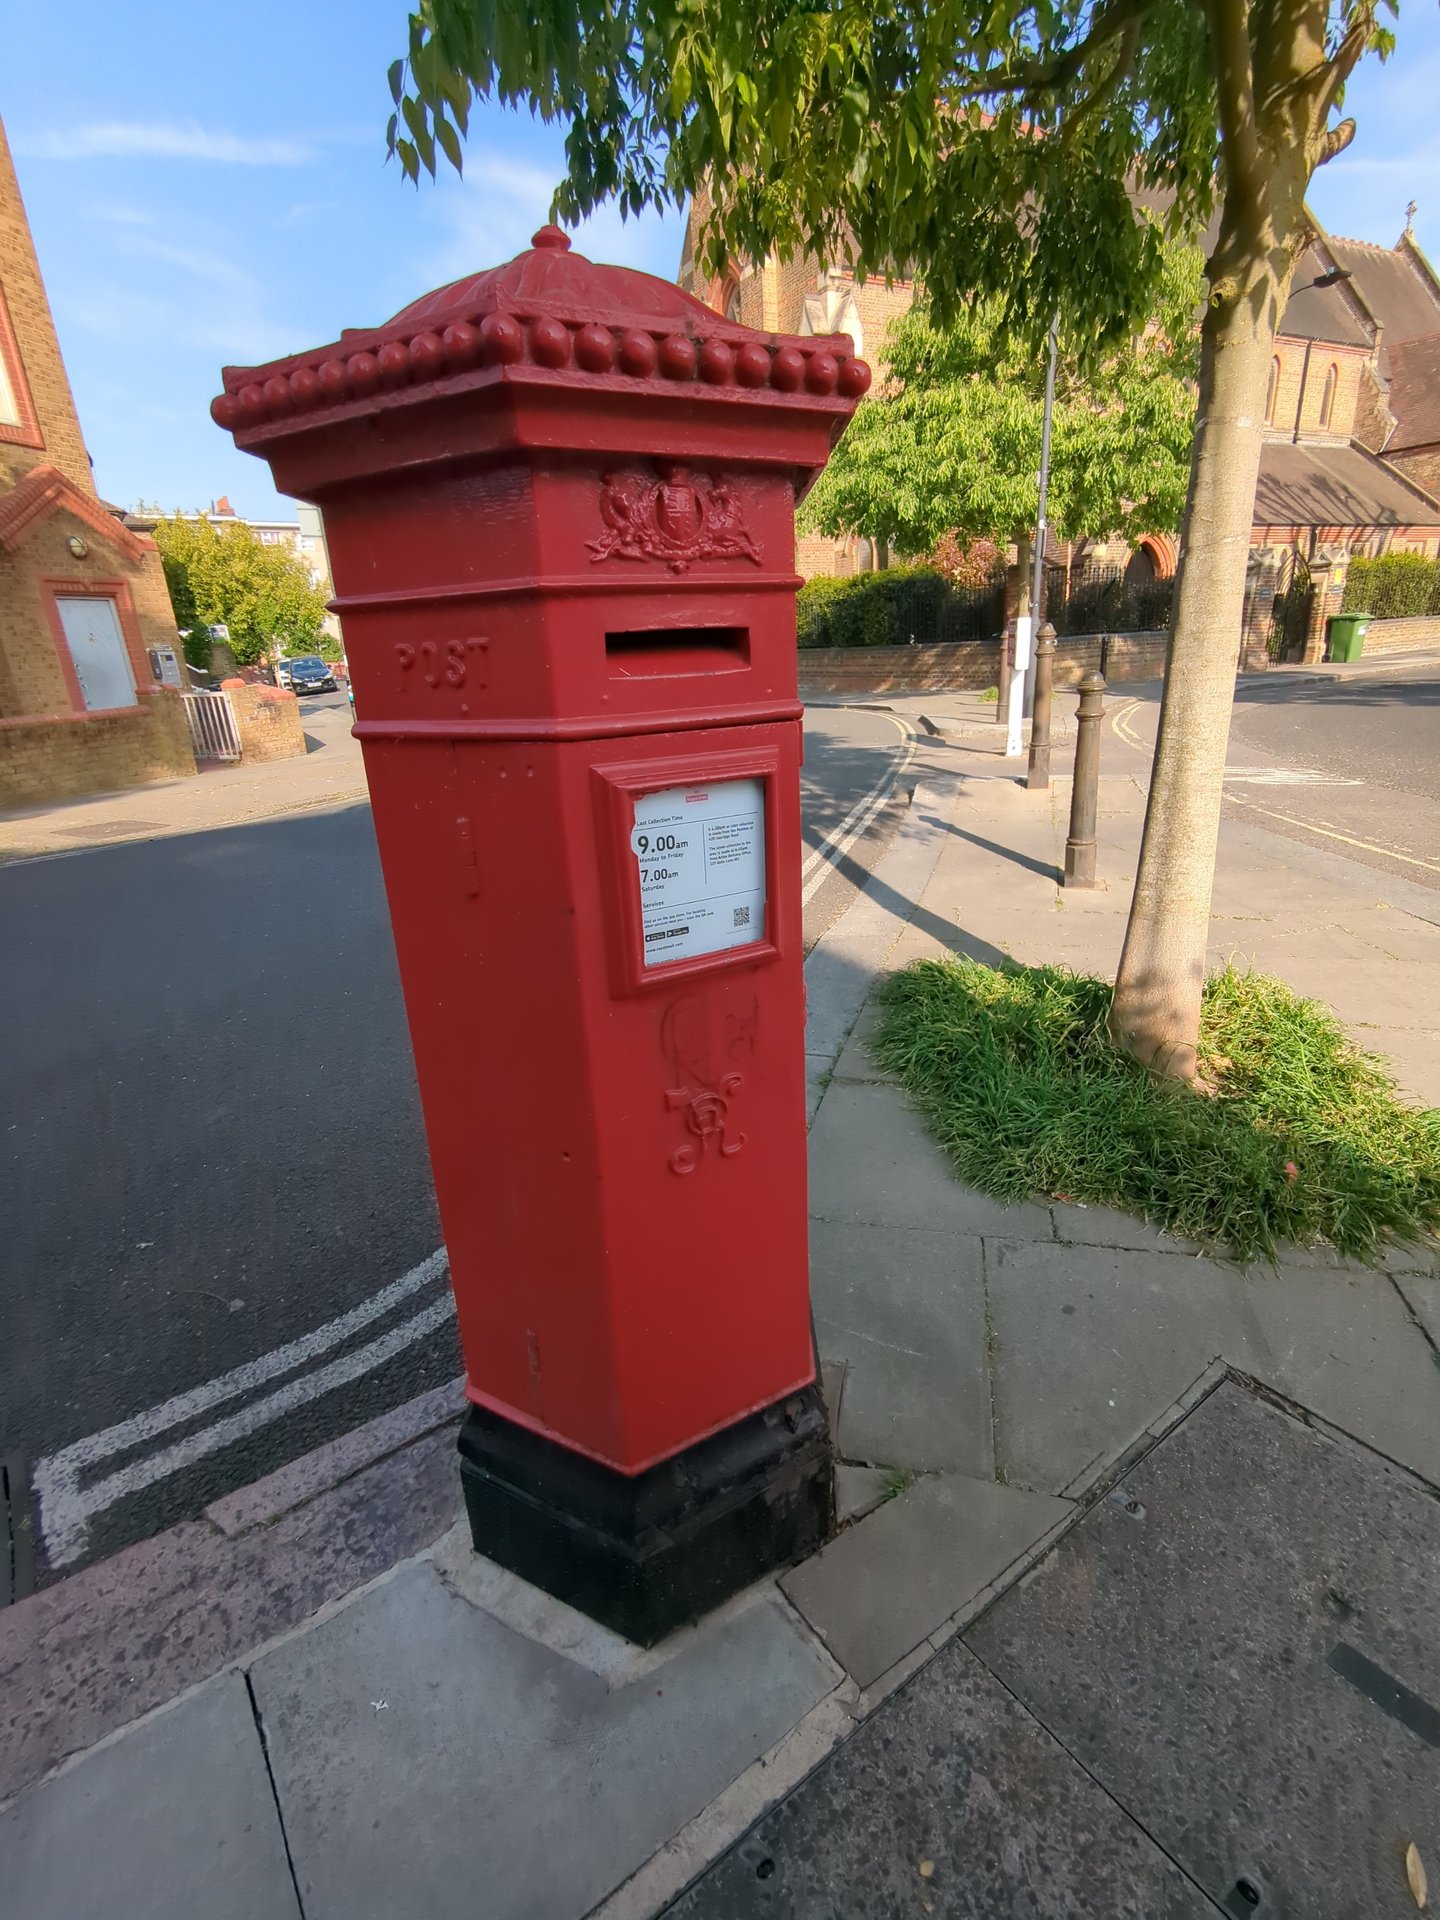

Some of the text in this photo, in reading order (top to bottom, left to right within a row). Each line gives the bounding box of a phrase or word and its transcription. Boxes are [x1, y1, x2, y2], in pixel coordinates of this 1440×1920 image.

[394, 637, 489, 692] POST
[647, 817, 671, 825] Collection
[637, 834, 689, 855] 9.00am
[640, 868, 679, 883] 7.00am
[641, 884, 665, 892] Saturday
